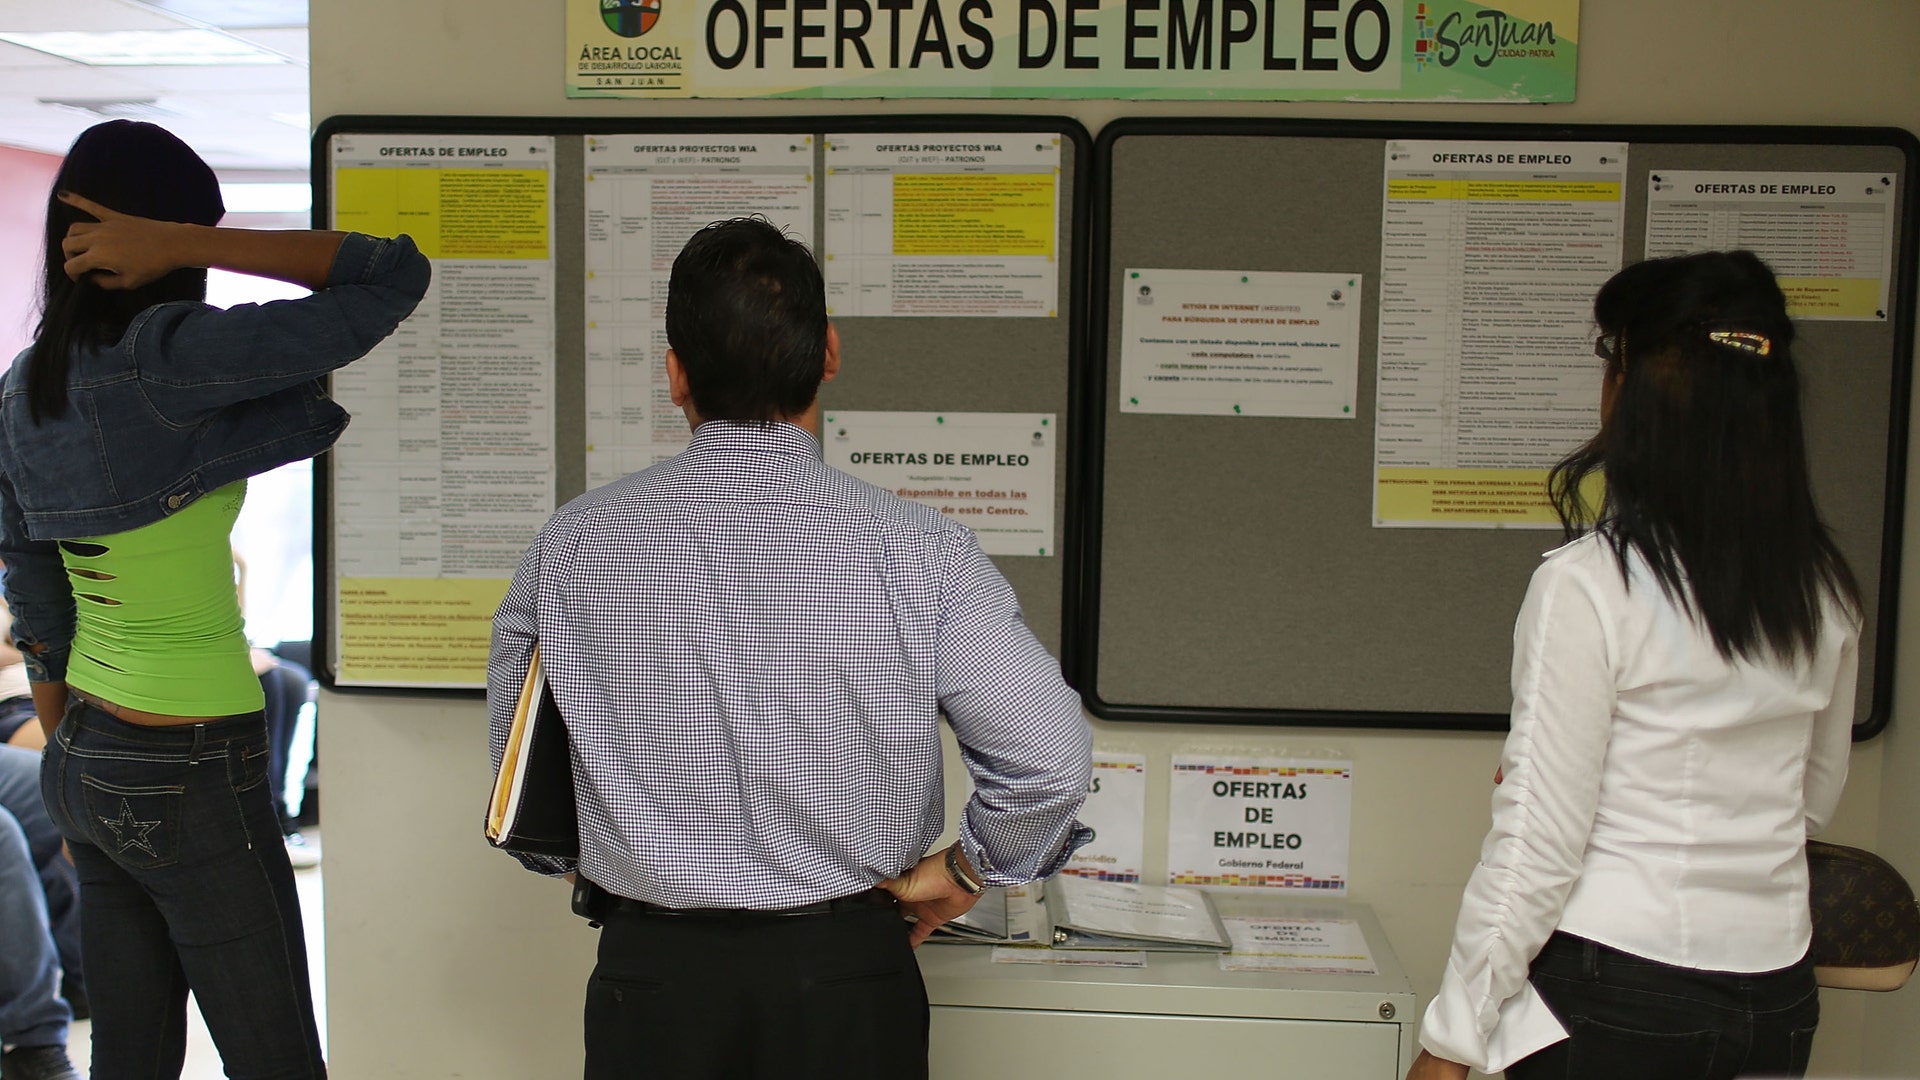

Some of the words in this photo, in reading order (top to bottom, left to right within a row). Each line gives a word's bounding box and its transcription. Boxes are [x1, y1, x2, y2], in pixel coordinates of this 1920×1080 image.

[705, 0, 994, 70] OFERTAS
[1018, 0, 1099, 70] DE
[1124, 0, 1391, 72] EMPLEO
[580, 44, 622, 60] ÁREA
[628, 46, 682, 60] LOCAL
[1497, 49, 1526, 58] CIUDAD
[1528, 50, 1556, 58] PATRIA
[578, 62, 589, 70] DE
[591, 62, 643, 70] DESARROLLO
[645, 62, 682, 70] LABORAL
[596, 78, 622, 86] SAN
[630, 78, 665, 86] JUAN
[380, 146, 435, 157] OFERTAS
[438, 147, 454, 157] DE
[458, 147, 508, 158] EMPLEO
[634, 145, 678, 153] OFERTAS
[679, 145, 737, 153] PROYECTOS
[738, 145, 757, 153] WIA
[876, 144, 921, 152] OFERTAS
[922, 144, 981, 152] PROYECTOS
[984, 144, 1002, 152] WIA
[1432, 153, 1493, 164] OFERTAS
[1497, 154, 1514, 164] DE
[1518, 154, 1572, 164] EMPLEO
[1694, 184, 1756, 194] OFERTAS
[1760, 184, 1778, 194] DE
[1781, 185, 1836, 195] EMPLEO
[850, 452, 928, 465] OFERTAS
[934, 454, 955, 465] DE
[961, 454, 1030, 466] EMPLEO
[896, 488, 954, 499] disponible
[975, 490, 1006, 498] todas
[1010, 490, 1027, 498] las
[941, 506, 955, 514] de
[959, 507, 983, 515] este
[987, 506, 1028, 516] Centro.
[1212, 780, 1307, 800] OFERTAS
[1244, 808, 1273, 824] DE
[1214, 831, 1302, 850] EMPLEO
[1218, 858, 1263, 869] Gobierno
[1266, 860, 1304, 870] Federal
